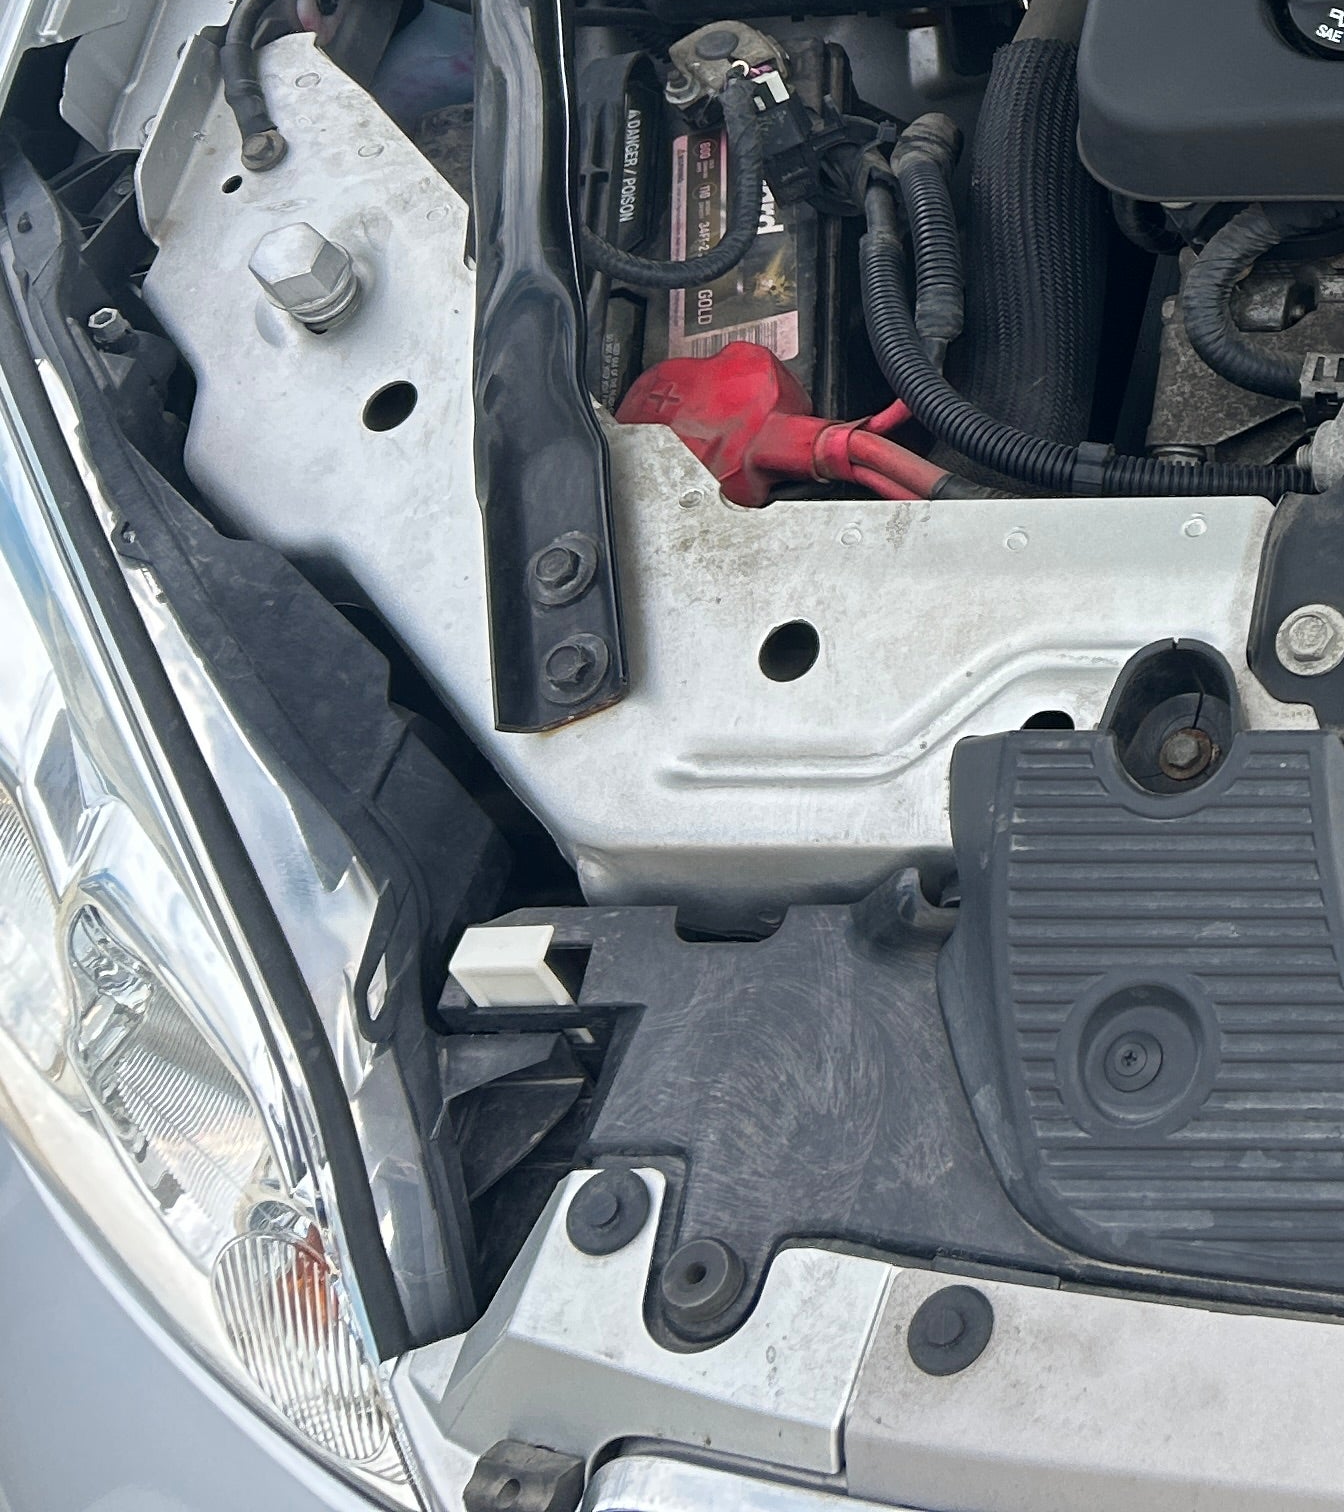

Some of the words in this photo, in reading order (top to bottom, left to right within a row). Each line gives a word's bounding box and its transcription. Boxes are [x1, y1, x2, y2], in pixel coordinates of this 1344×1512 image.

[1316, 24, 1344, 44] SAE
[623, 119, 640, 167] DANGER
[619, 177, 635, 222] POISON
[697, 289, 712, 325] GOLD
